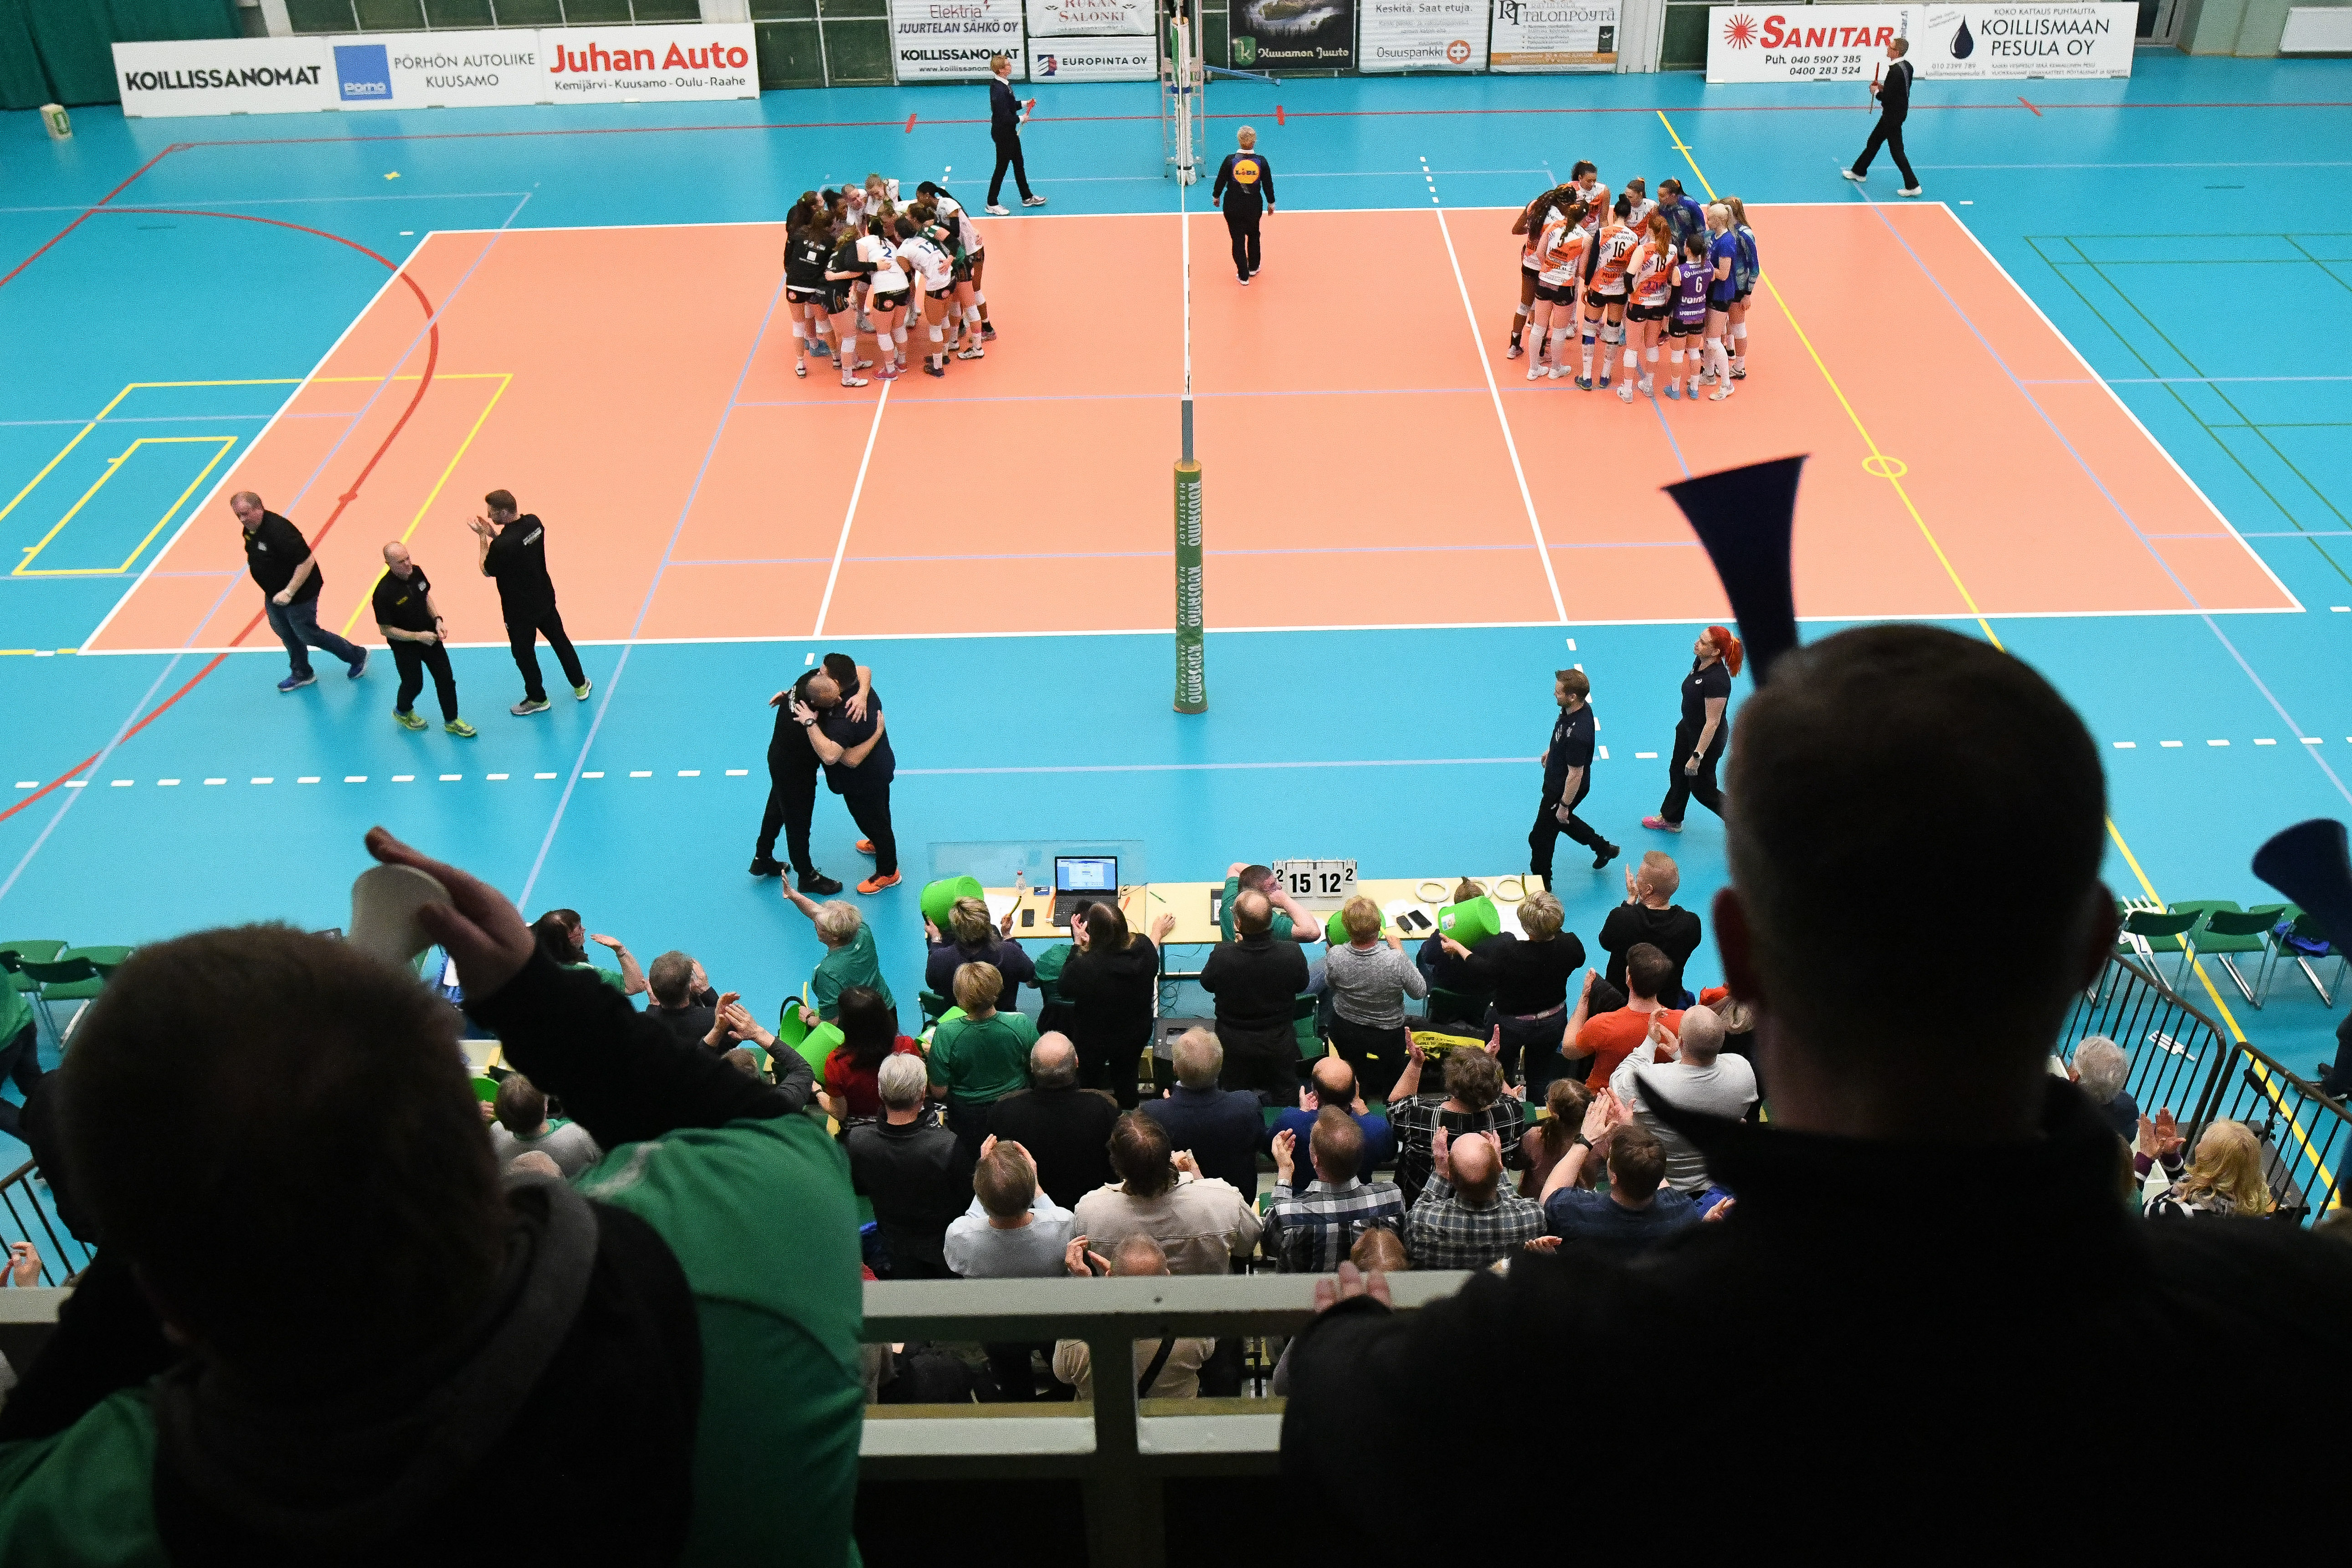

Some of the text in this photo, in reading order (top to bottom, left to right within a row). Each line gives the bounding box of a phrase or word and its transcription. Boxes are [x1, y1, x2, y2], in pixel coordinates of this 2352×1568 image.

[930, 5, 982, 18] Elektria
[1419, 3, 1441, 12] Saat
[899, 20, 1018, 33] JUURTELAN SÄHKÖ OY
[1760, 15, 1894, 48] SANITAR
[1982, 19, 2110, 36] KOILLISMAAN
[900, 49, 1019, 60] KOILLISSANOMAT
[1377, 47, 1443, 59] Osuuspankki
[1992, 39, 2095, 56] PESULA OY
[395, 52, 535, 69] PÖRHÖN AUTOLIIKE
[550, 41, 749, 73] Juhan Auto
[1063, 57, 1129, 66] EUROPINTA
[1791, 56, 1810, 64] 040
[126, 66, 321, 90] KOILLISSANOMAT
[426, 74, 499, 88] KUUSAMO
[615, 78, 667, 89] Kuusamo
[675, 77, 703, 87] Oulu
[710, 77, 746, 87] Raahe
[883, 246, 892, 258] 2
[1613, 241, 1626, 258] 16
[1654, 255, 1667, 272] 18
[1695, 276, 1703, 293] 6
[1188, 480, 1202, 546] KUUSAMO
[1187, 564, 1202, 627] KUUSAMO
[1187, 643, 1202, 703] KUUSAMO
[1276, 869, 1284, 882] 2
[1289, 873, 1311, 893] 15
[1319, 873, 1341, 893] 12
[1345, 868, 1354, 881] 2
